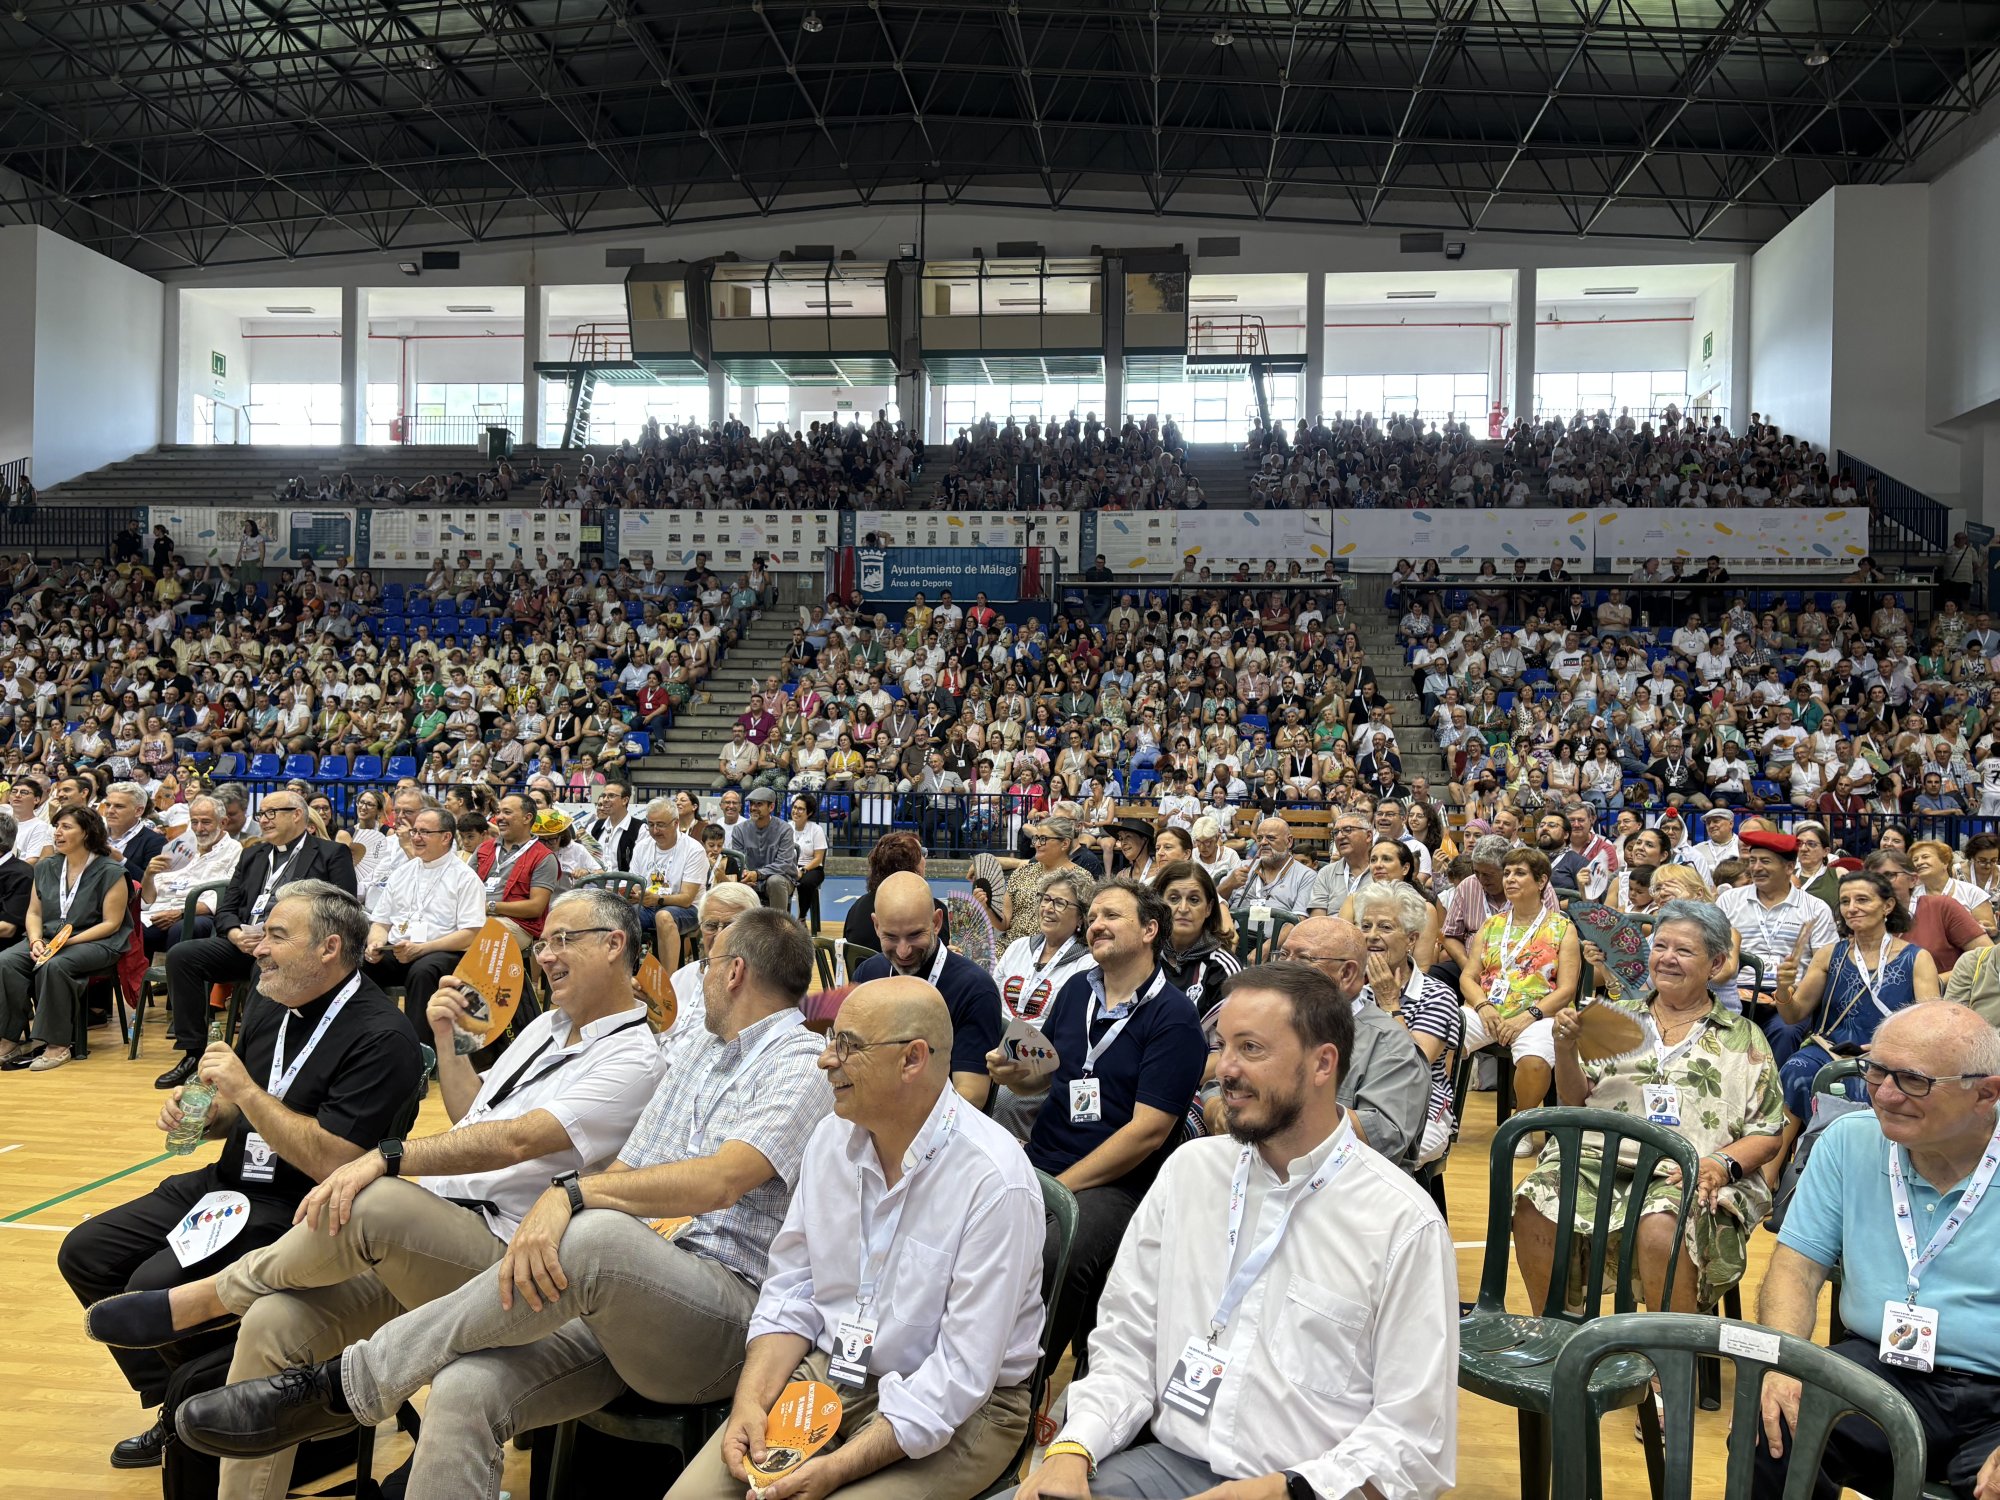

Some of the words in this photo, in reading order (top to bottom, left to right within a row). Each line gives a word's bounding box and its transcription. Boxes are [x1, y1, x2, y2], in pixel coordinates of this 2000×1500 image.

[891, 564, 962, 577] Ayuntamiento
[964, 564, 977, 575] de
[980, 564, 1017, 577] Málaga
[890, 578, 909, 588] Área
[910, 579, 920, 587] de
[922, 579, 953, 589] Deporte
